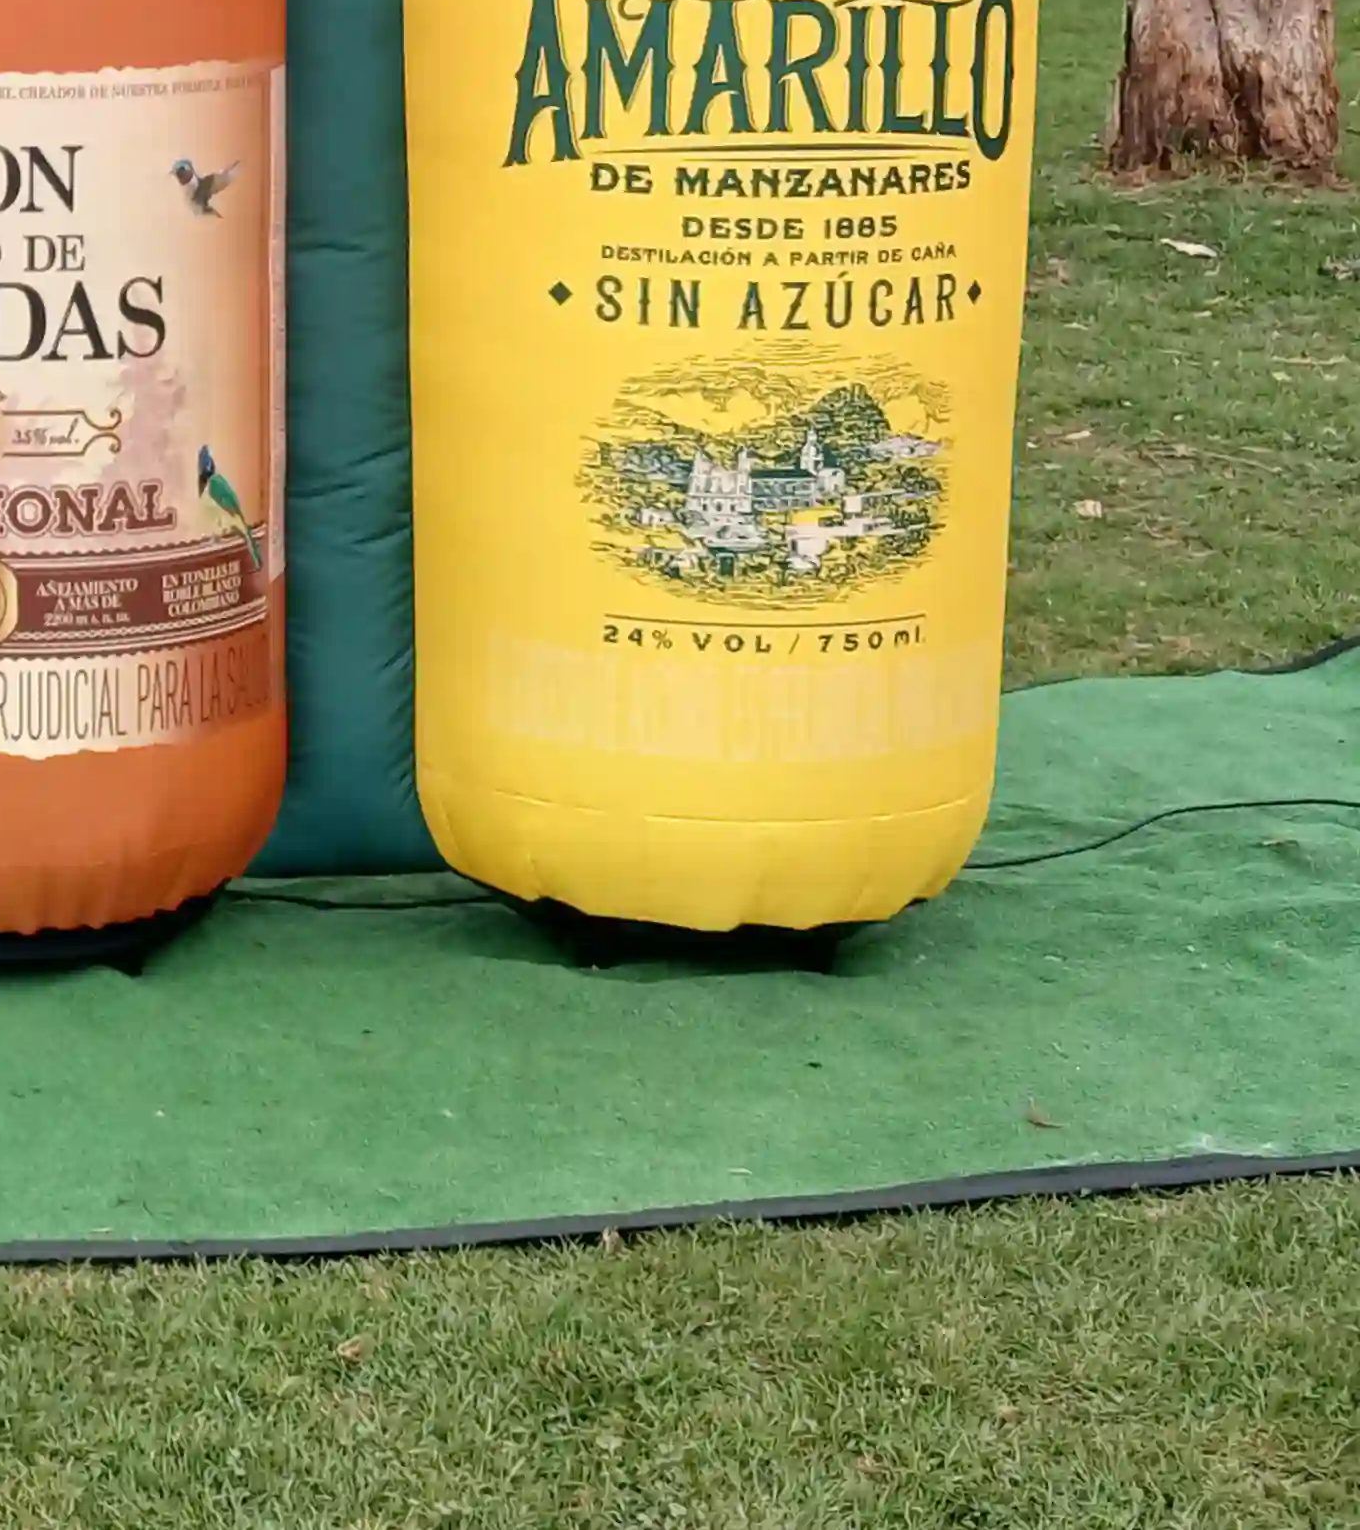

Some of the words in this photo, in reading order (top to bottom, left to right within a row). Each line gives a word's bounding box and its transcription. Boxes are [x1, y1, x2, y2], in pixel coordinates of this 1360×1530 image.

[590, 163, 653, 194] DE
[675, 159, 971, 198] MANZANARES
[682, 216, 805, 240] DESDE
[824, 215, 897, 239] 1885
[24, 234, 86, 272] DE
[601, 245, 752, 267] DESTILACIÓN
[762, 252, 780, 267] A
[789, 250, 869, 267] PARTIR
[877, 248, 903, 264] DE
[911, 241, 957, 262] CAÑA
[595, 274, 701, 328] SIN
[737, 271, 957, 330] AZÚCAR
[602, 624, 673, 652] 24%
[691, 631, 772, 655] VOL
[137, 656, 193, 735] PARA
[200, 651, 221, 723] LA
